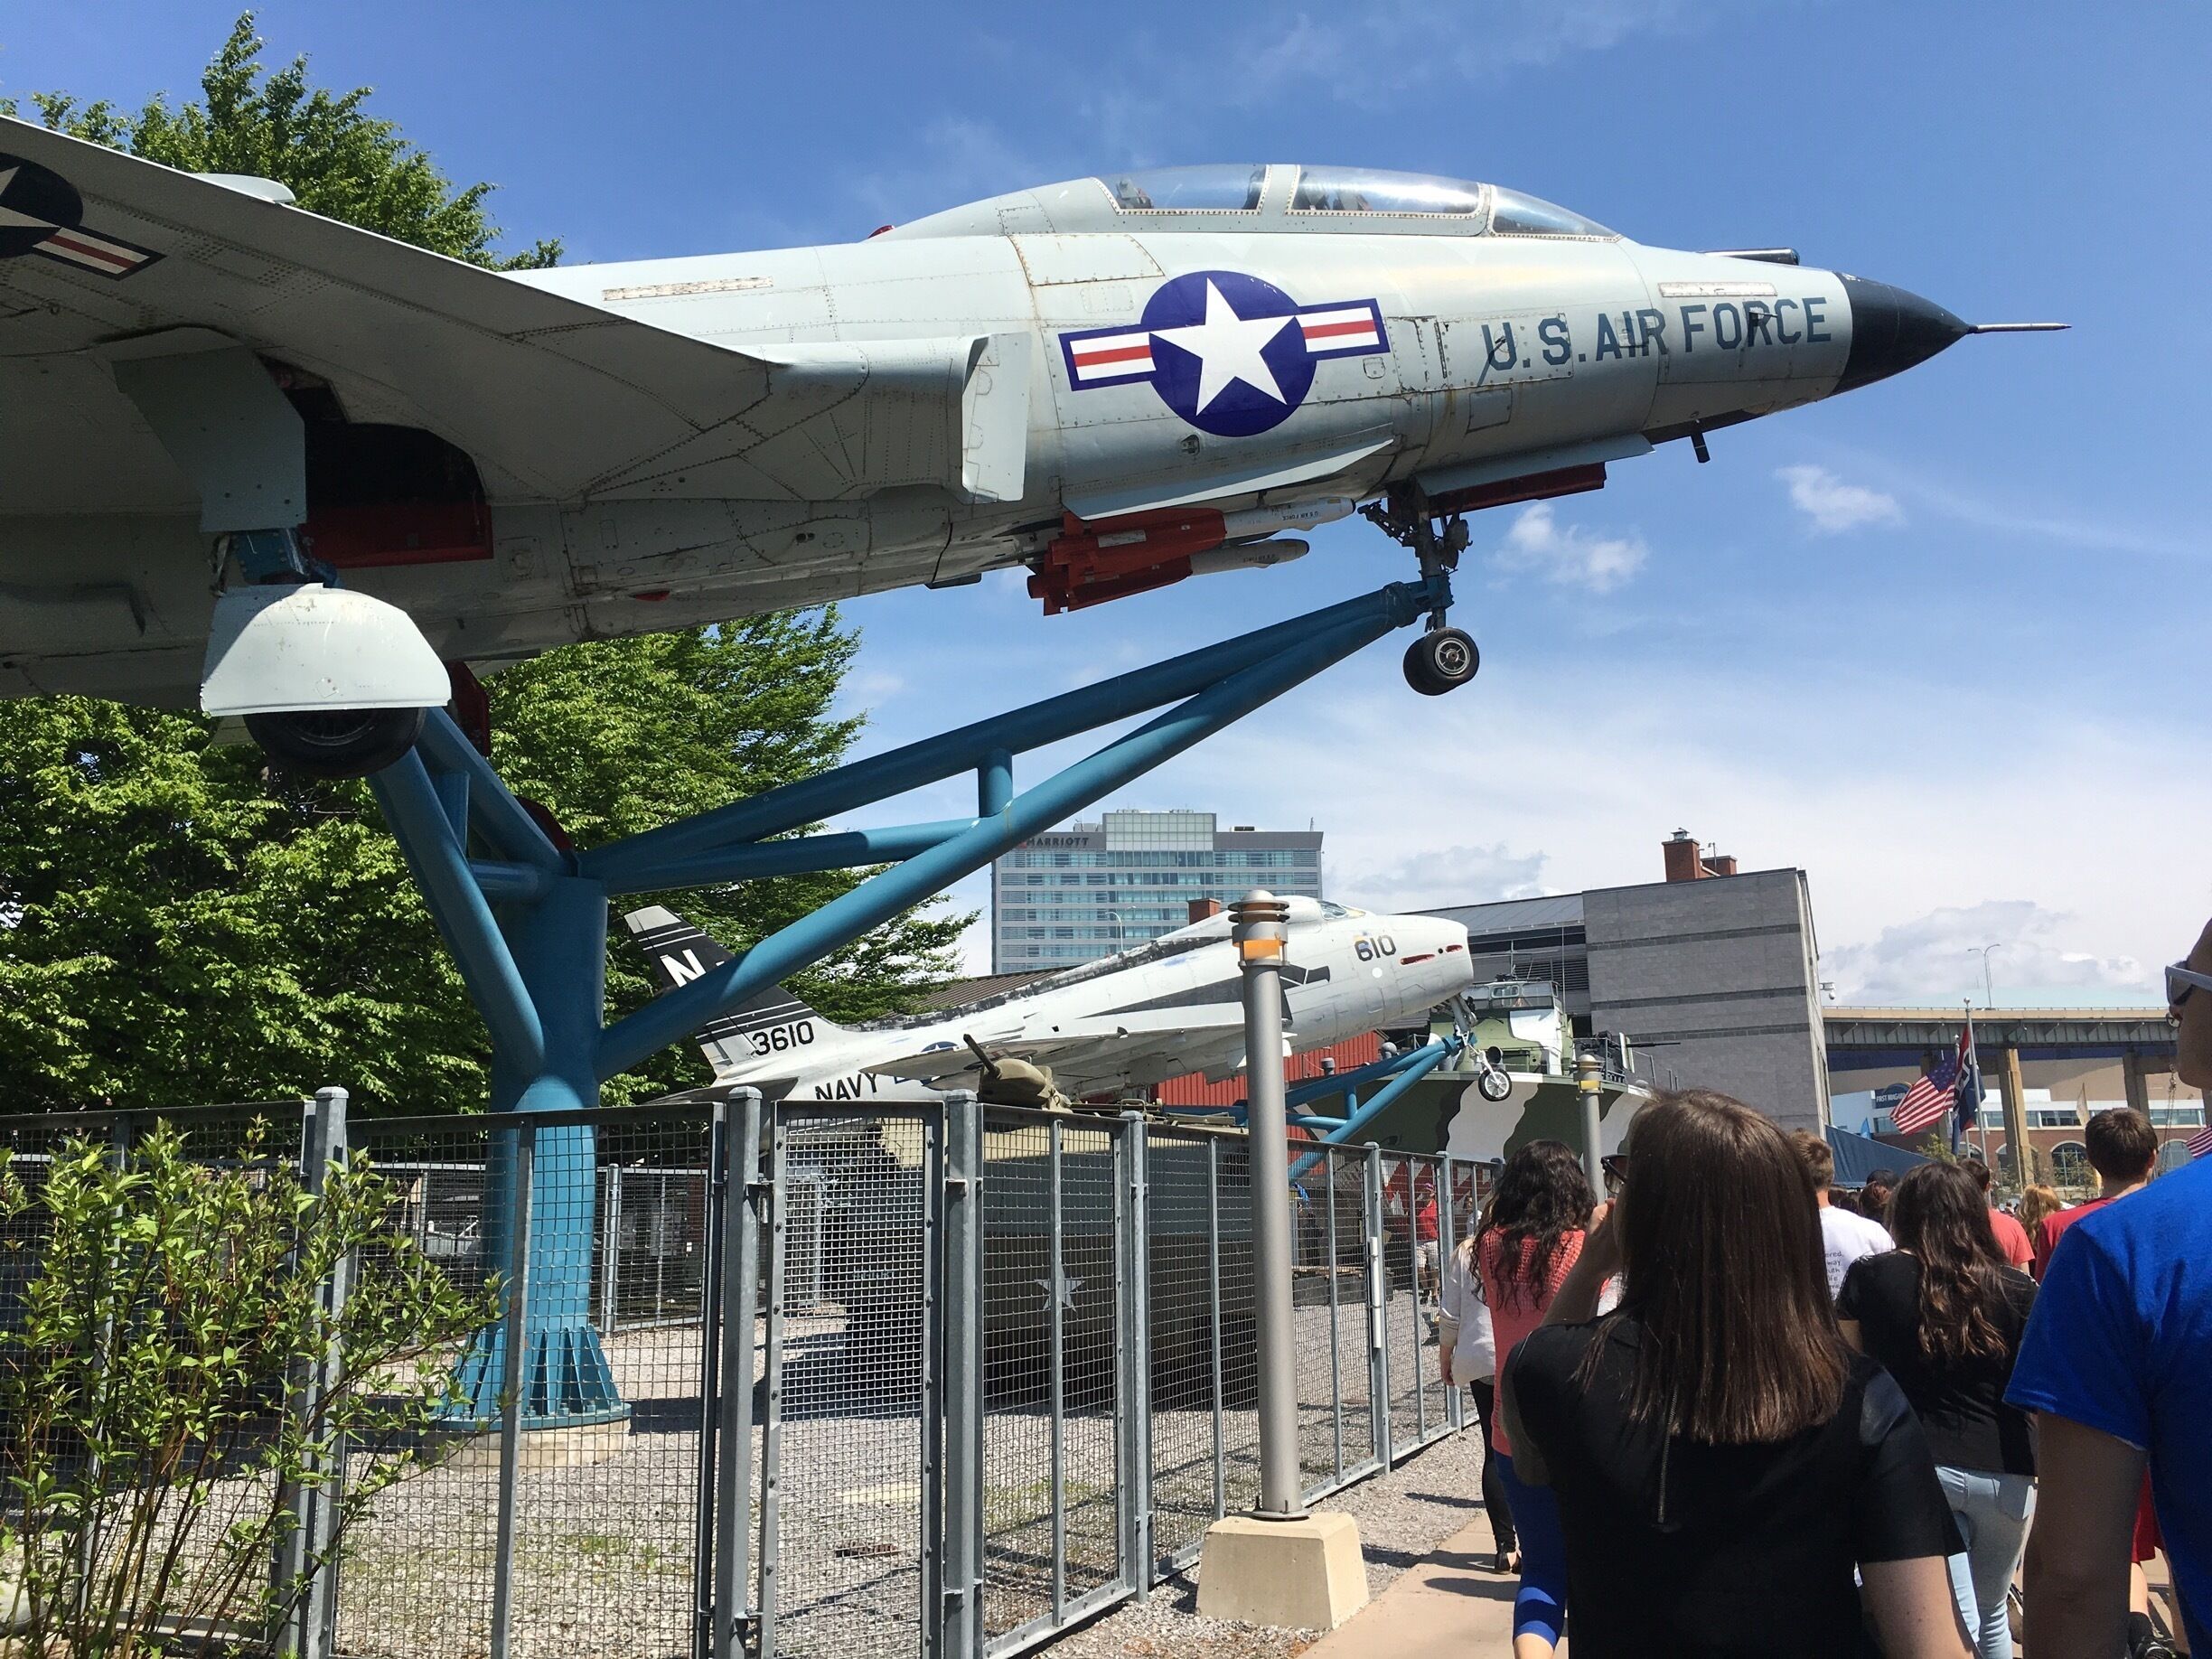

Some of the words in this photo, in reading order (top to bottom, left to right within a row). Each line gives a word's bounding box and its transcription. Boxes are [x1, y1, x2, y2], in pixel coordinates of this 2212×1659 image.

[1481, 316, 1587, 371] U.S.
[1596, 307, 1670, 361] AIR
[1680, 296, 1832, 353] FORCE
[1026, 837, 1090, 847] MARRIOTT
[1354, 933, 1397, 961] 610
[660, 949, 725, 988] N
[752, 1020, 815, 1056] 3610
[815, 1073, 877, 1101] NAVY
